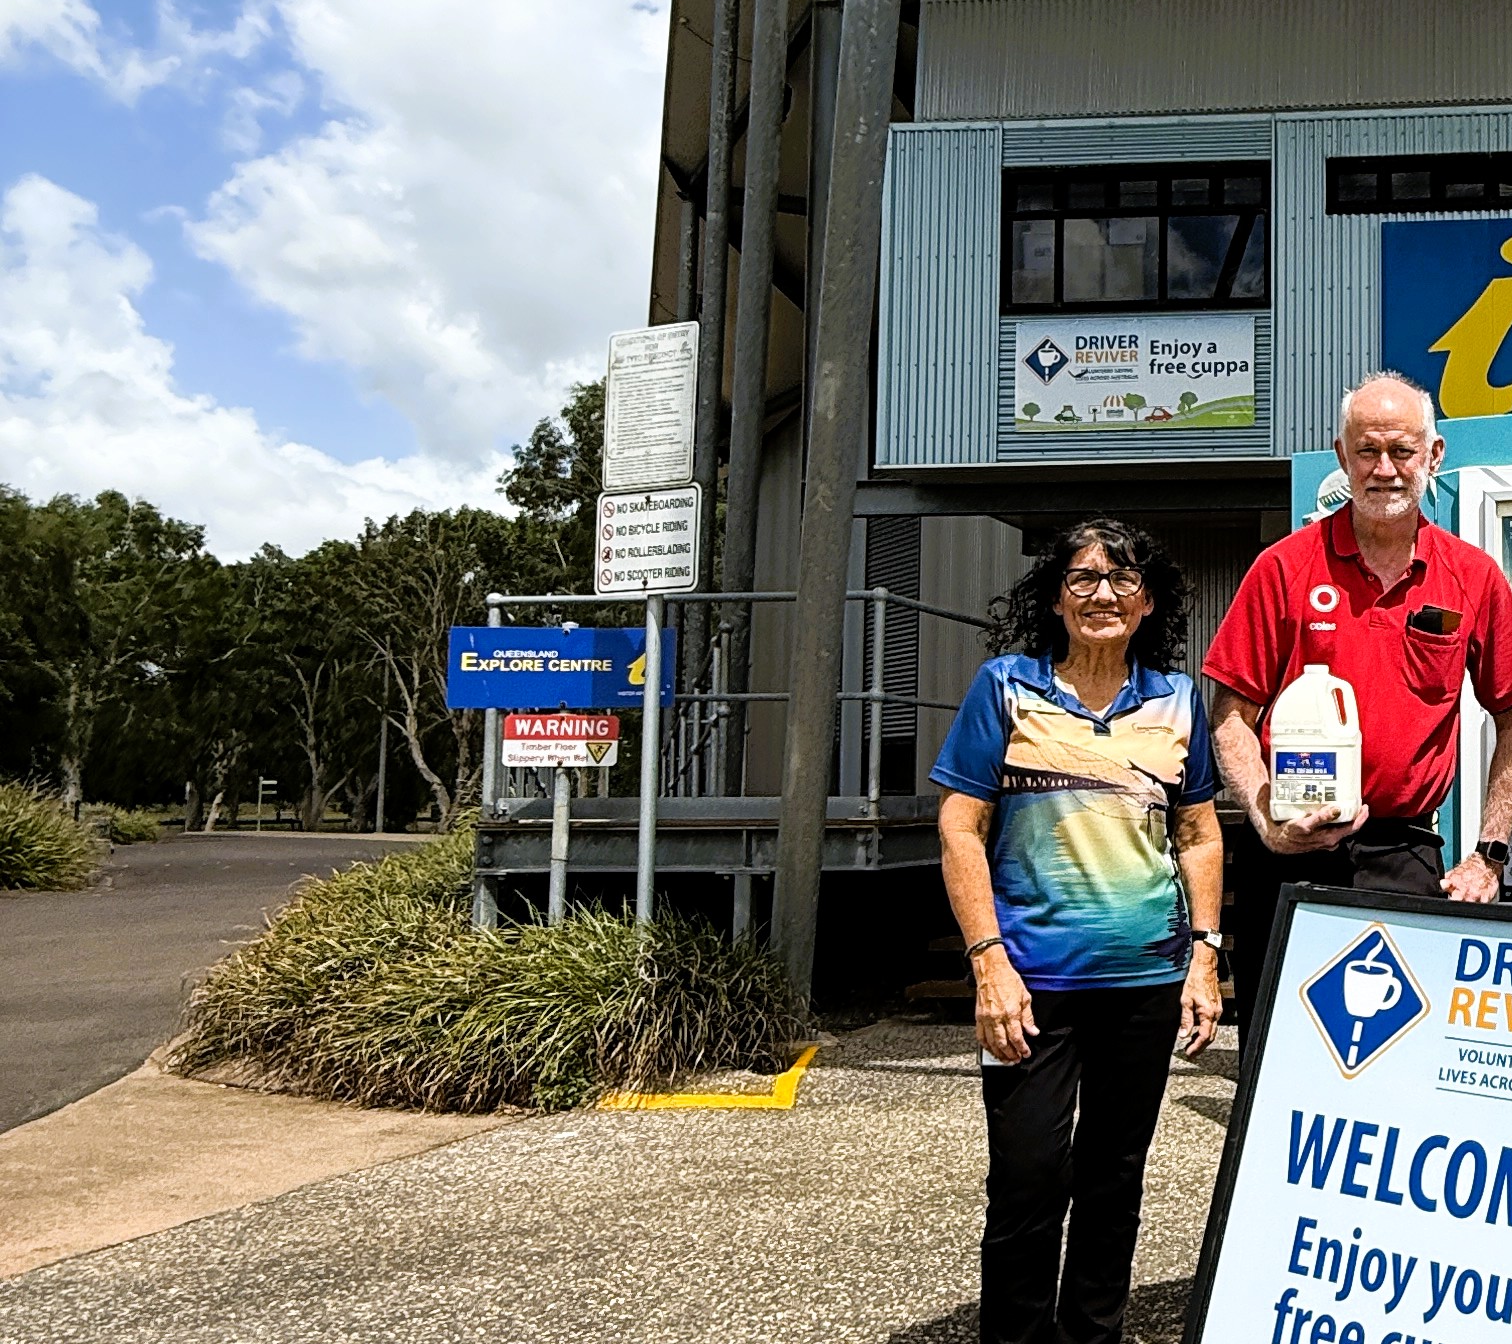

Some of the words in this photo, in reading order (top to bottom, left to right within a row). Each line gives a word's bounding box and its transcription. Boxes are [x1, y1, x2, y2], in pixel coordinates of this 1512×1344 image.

[1075, 334, 1139, 350] DRIVER
[1150, 338, 1202, 358] Enjoy
[1206, 342, 1217, 354] a
[1075, 350, 1138, 364] REVIVER
[1149, 358, 1187, 375] free
[1191, 359, 1249, 377] cuppa
[616, 503, 628, 514] NO
[629, 497, 693, 513] SKATEBOARDING
[616, 526, 627, 536] NO
[629, 523, 660, 535] BICYCLE
[663, 520, 688, 532] RIDING
[615, 548, 626, 559] NO
[628, 543, 690, 558] ROLLERBLADING
[614, 571, 625, 581] NO
[627, 568, 662, 580] SCOOTER
[665, 566, 690, 577] RIDING
[461, 652, 544, 672] EXPLORE
[548, 659, 612, 672] CENTRE
[493, 650, 558, 658] QUEENSLAND
[515, 719, 609, 736] WARNING
[521, 742, 551, 751] Timber
[555, 742, 577, 751] Floor
[507, 753, 544, 764] Slippery
[547, 754, 570, 763] When
[1438, 1067, 1476, 1085] LIVES
[1287, 1215, 1418, 1314] Enjoy
